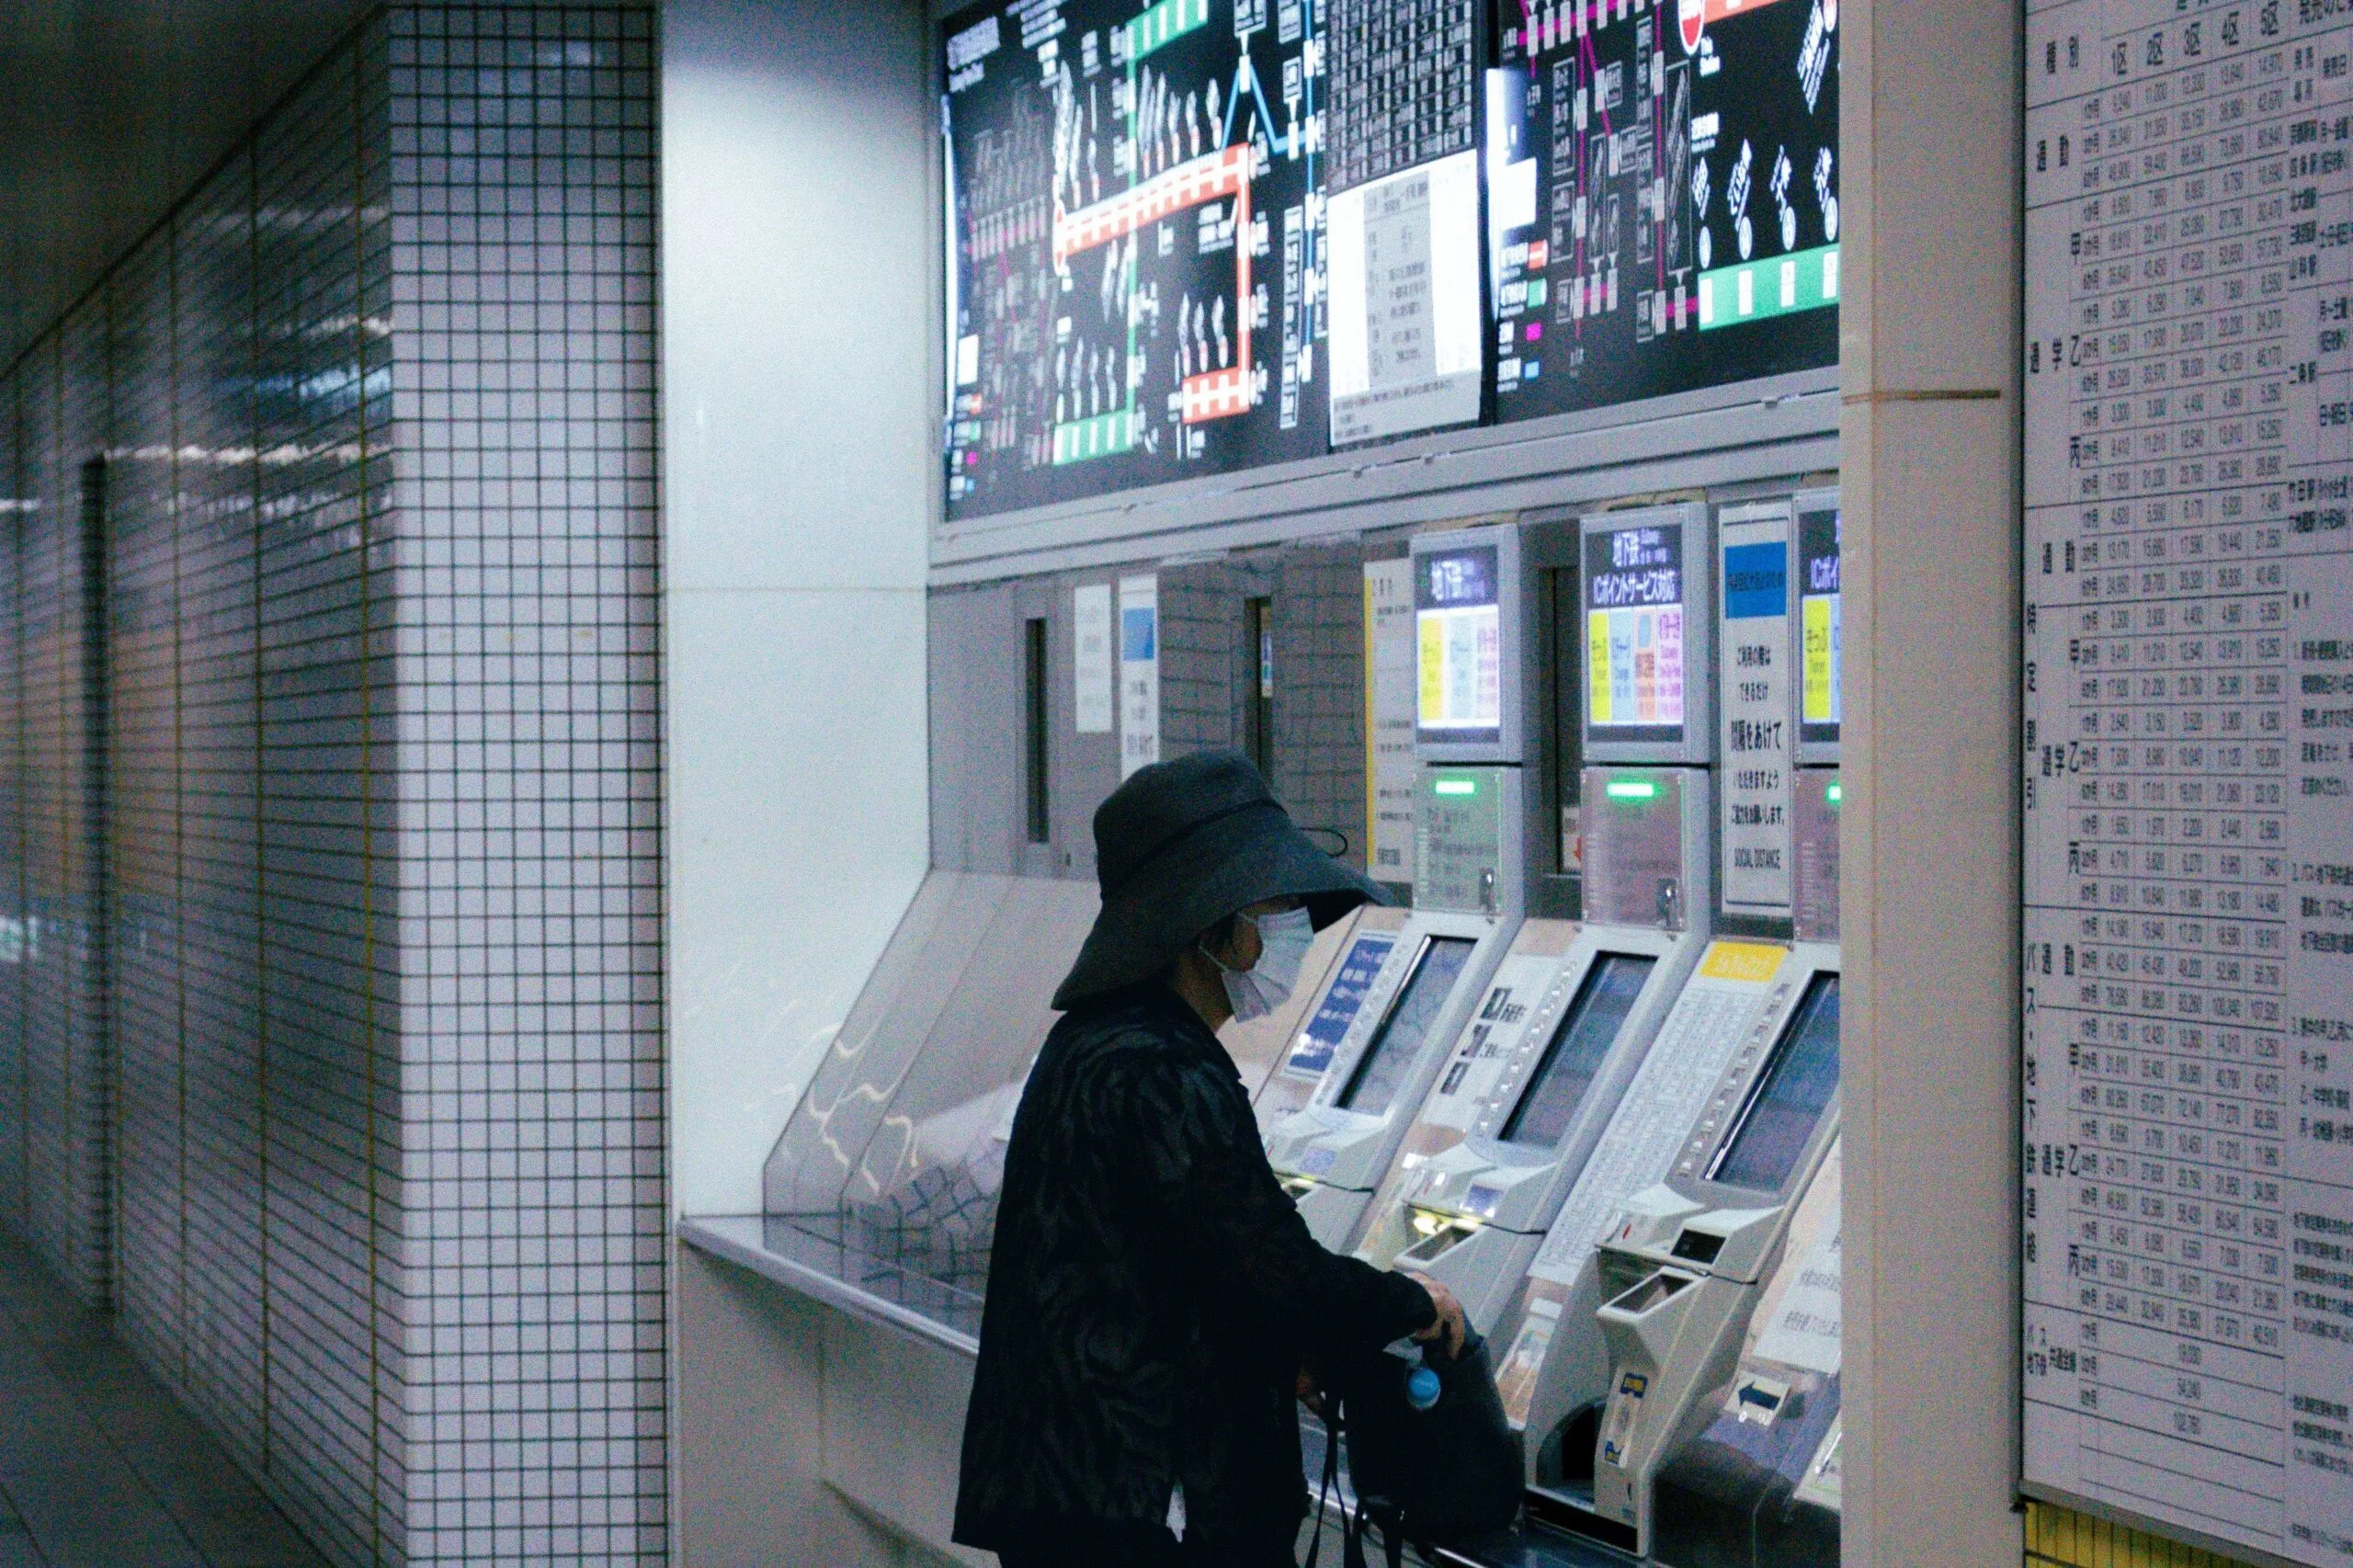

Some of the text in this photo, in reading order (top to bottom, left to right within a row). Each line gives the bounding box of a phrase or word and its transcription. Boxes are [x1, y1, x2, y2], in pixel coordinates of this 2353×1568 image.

[2112, 0, 2279, 75] 1区 2区 3区 4区 5区
[2070, 334, 2082, 368] 乙
[1593, 567, 1676, 605] ICポイントサービス対応
[1739, 681, 1768, 701] できるだけ
[1731, 720, 1782, 752] 間隔をあけて
[2068, 740, 2080, 774] 乙
[1733, 769, 1779, 790] いただきますよう
[2068, 1142, 2080, 1177] 乙
